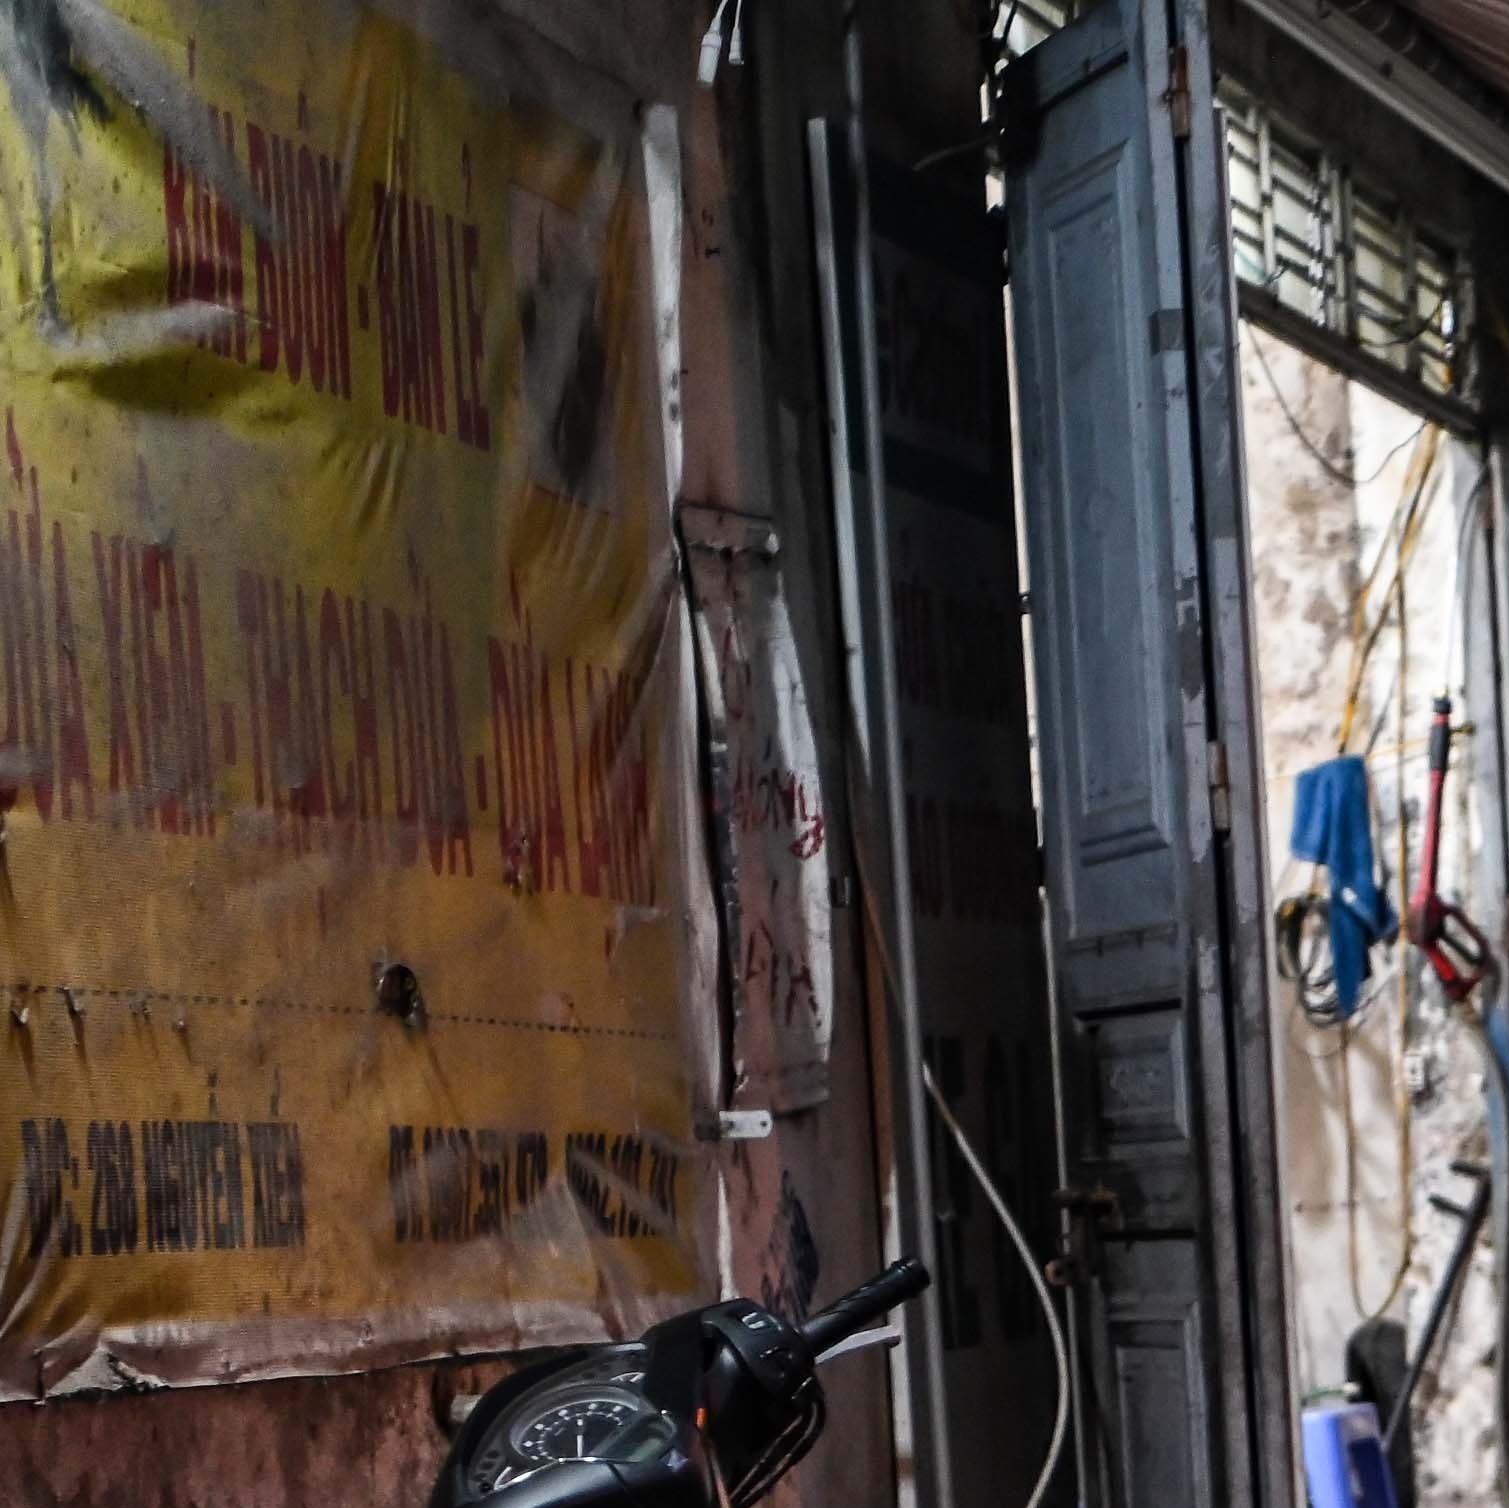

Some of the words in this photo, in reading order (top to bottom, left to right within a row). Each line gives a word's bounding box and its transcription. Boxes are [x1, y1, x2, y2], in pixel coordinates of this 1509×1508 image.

[244, 90, 352, 401] BUÔN
[373, 136, 447, 435] BÁN
[445, 142, 491, 452] LẺ
[488, 569, 572, 895] DỪA
